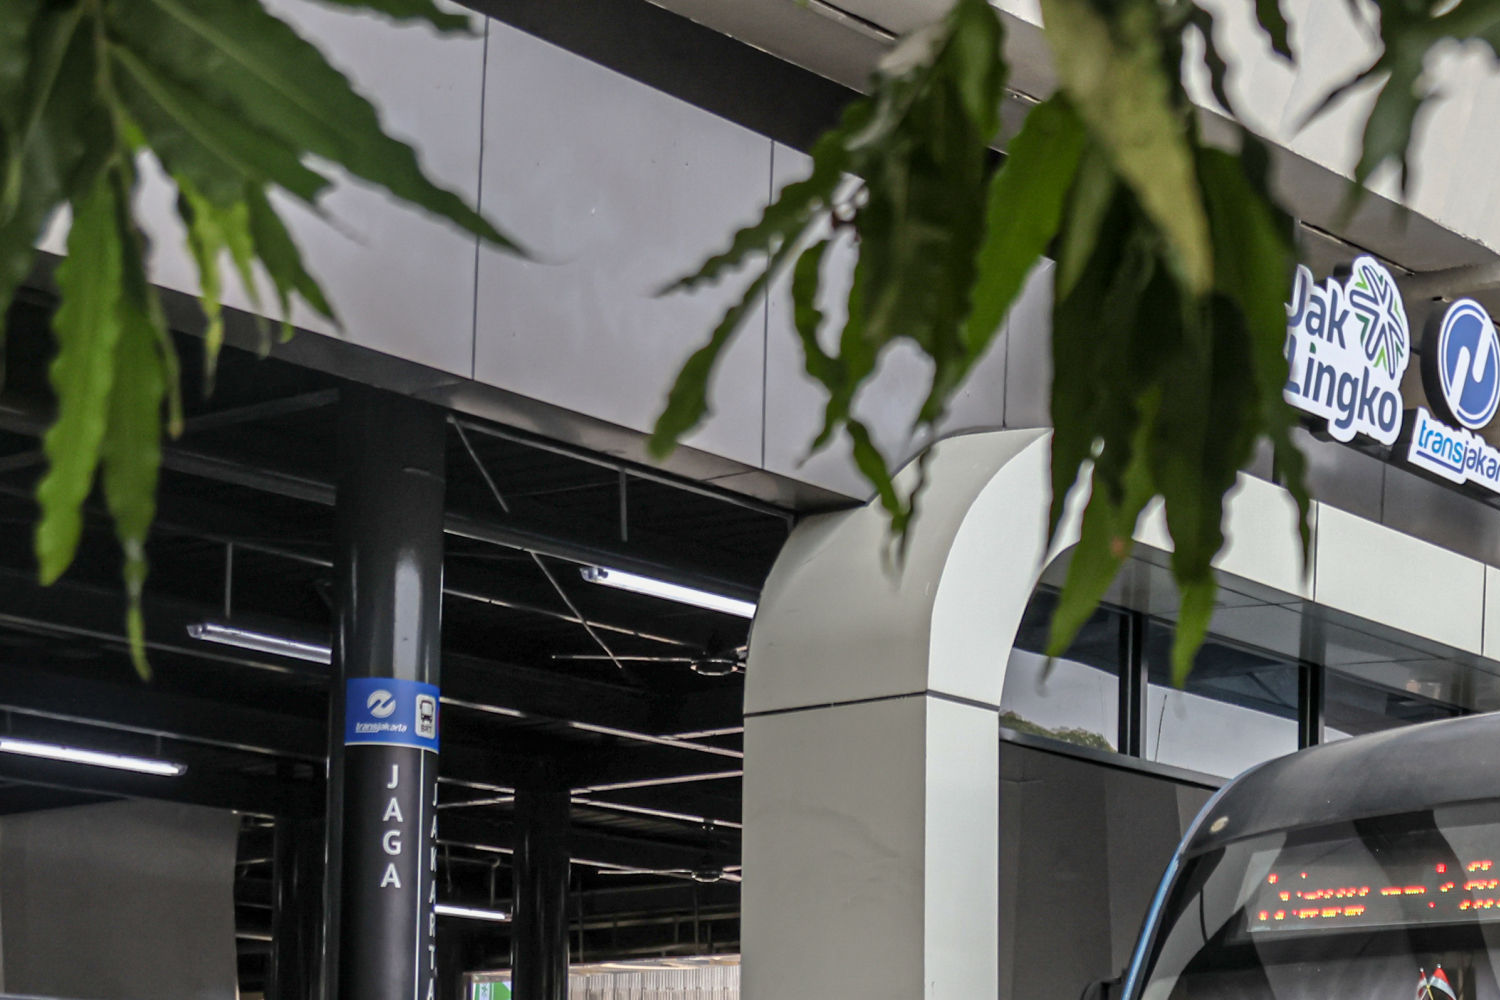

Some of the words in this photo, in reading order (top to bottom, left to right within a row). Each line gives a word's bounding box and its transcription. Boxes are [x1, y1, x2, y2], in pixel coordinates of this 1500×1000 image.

[1286, 274, 1350, 350] Jak
[1285, 334, 1398, 433] Lingko
[355, 722, 408, 734] transjakarta
[379, 764, 404, 889] JAGA
